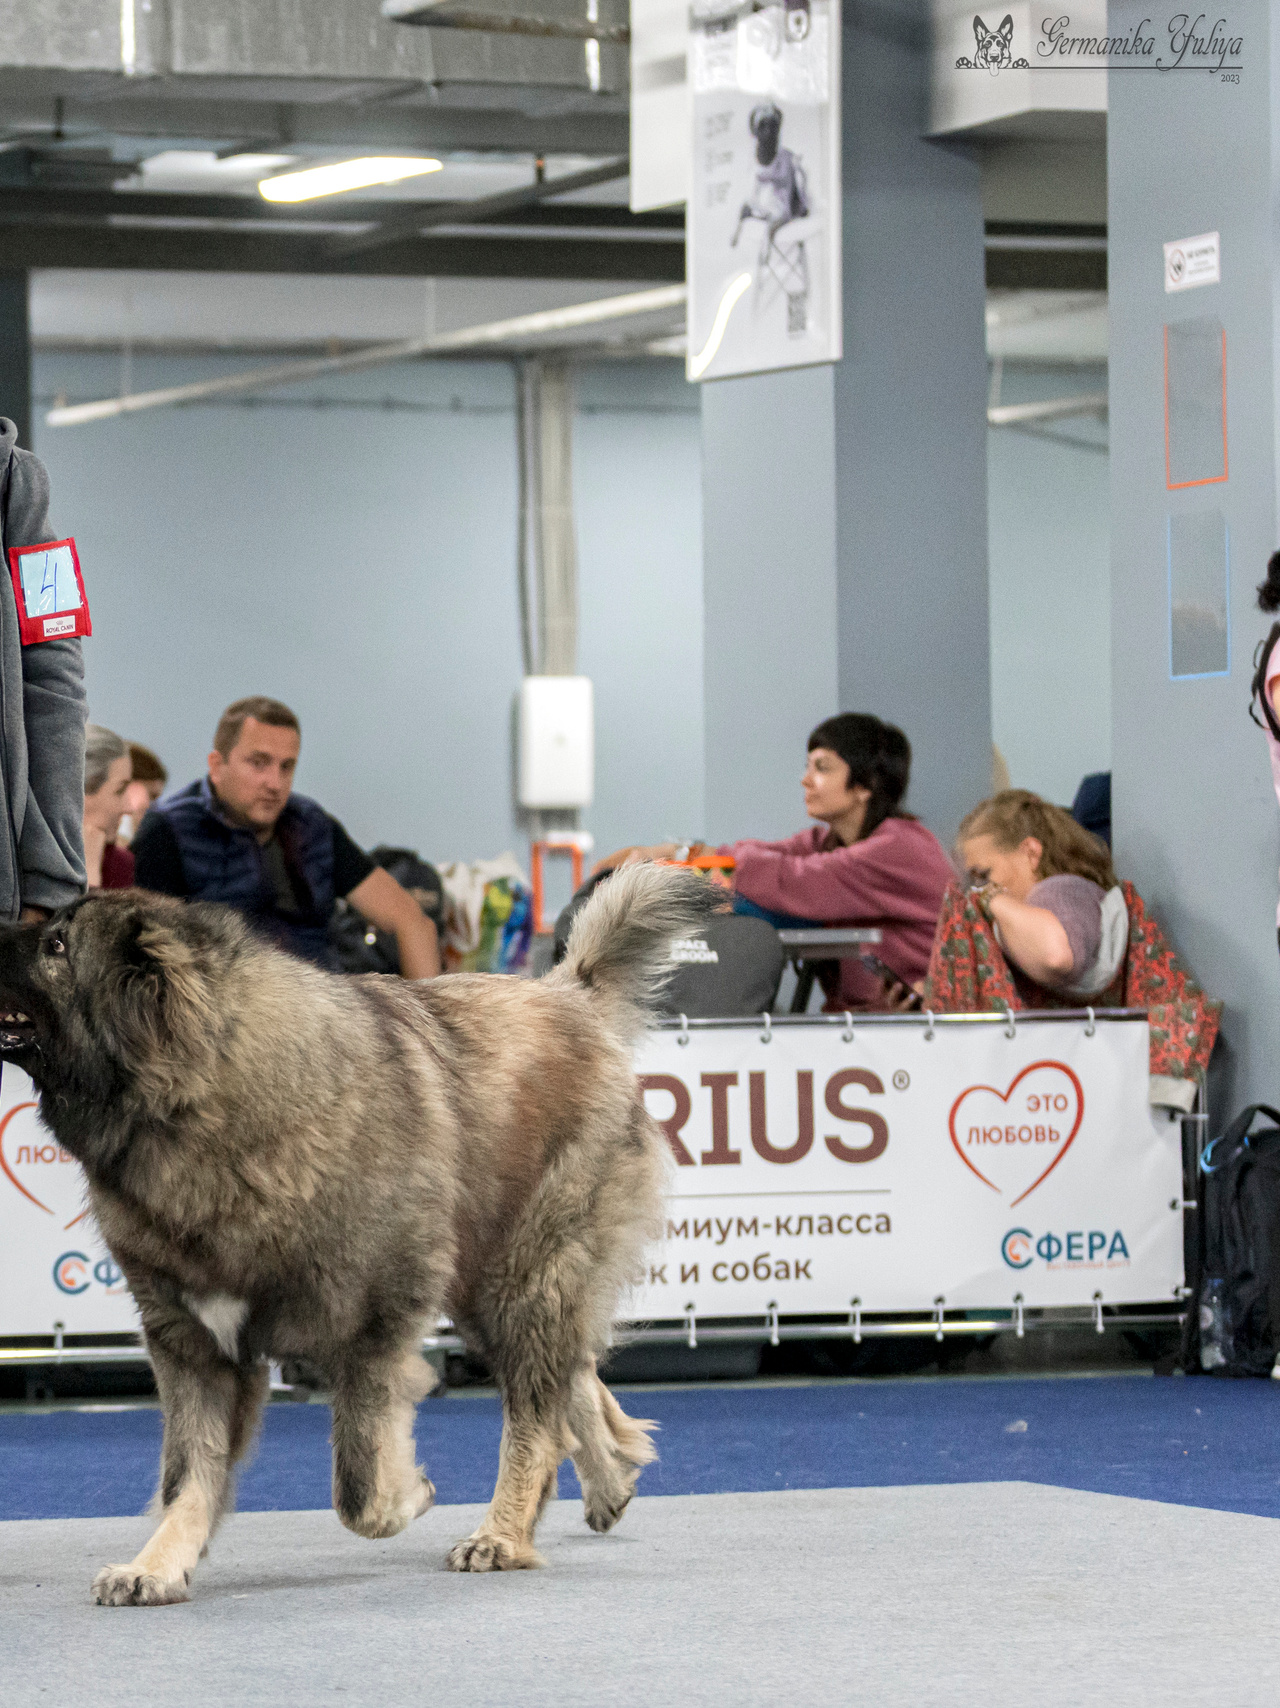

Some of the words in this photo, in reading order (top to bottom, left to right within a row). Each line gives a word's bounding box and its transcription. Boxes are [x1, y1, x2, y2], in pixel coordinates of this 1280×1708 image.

[1027, 1094, 1068, 1112] ЭТО
[967, 1125, 1061, 1145] ЛЮБОВЬ
[666, 1211, 892, 1246] миум-класса
[1001, 1228, 1130, 1269] СФЕРА
[680, 1263, 699, 1285] и
[711, 1252, 812, 1284] собак
